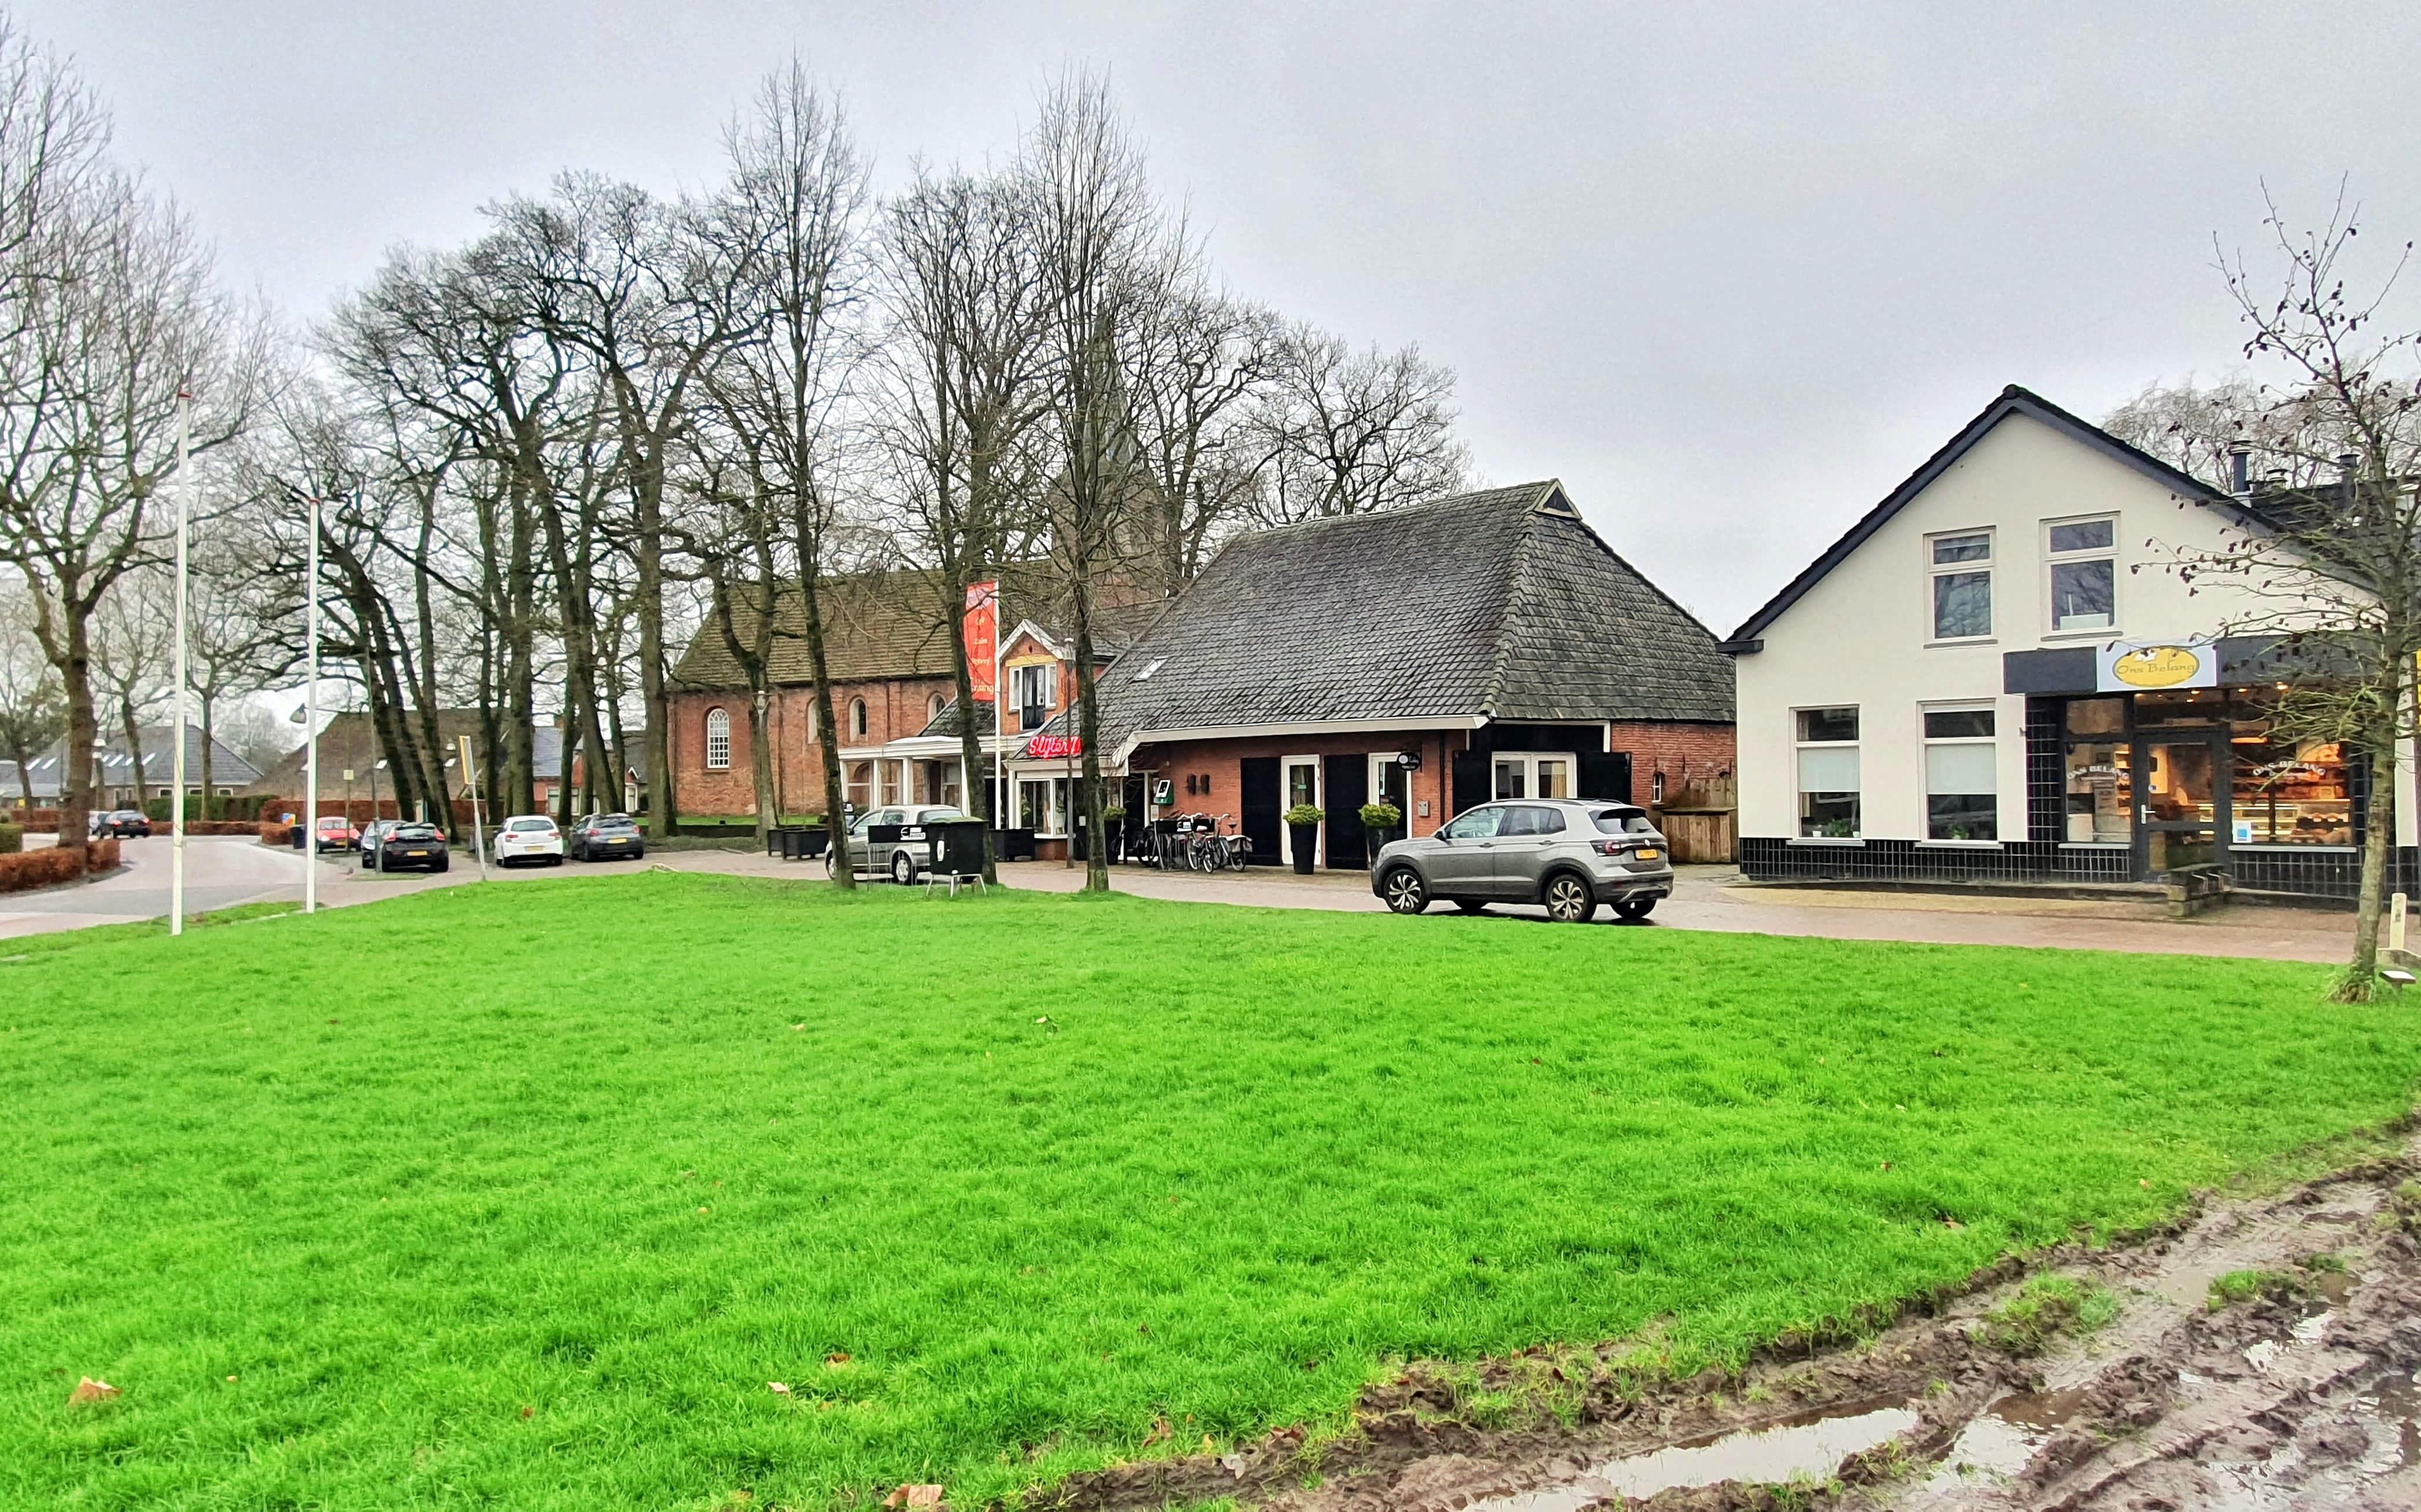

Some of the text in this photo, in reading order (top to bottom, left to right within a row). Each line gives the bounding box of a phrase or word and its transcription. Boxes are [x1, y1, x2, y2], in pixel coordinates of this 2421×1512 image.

[2116, 660, 2195, 674] Ons Belang
[2089, 765, 2129, 778] BELANG
[2252, 761, 2326, 776] ONS BELANG
